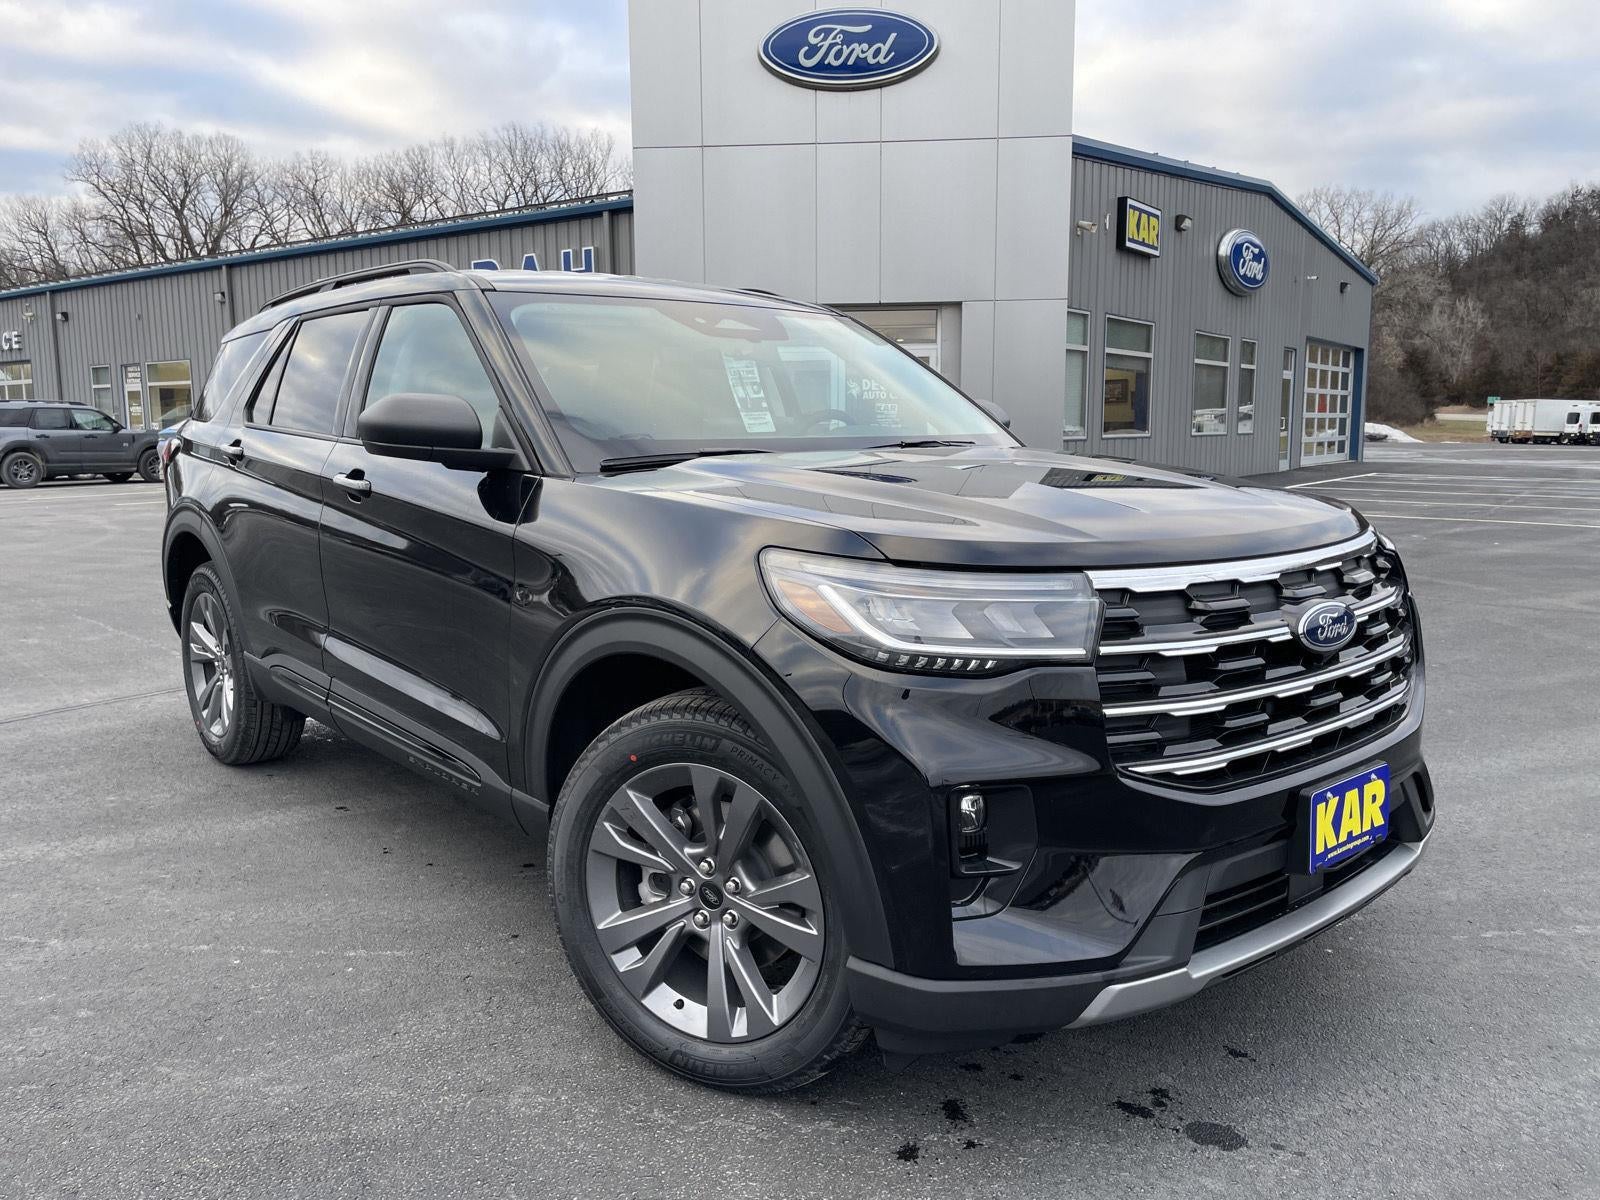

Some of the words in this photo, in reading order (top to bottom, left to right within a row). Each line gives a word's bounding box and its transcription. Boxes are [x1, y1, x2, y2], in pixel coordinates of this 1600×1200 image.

[798, 24, 898, 68] Ford
[1128, 208, 1159, 246] KAR
[1239, 242, 1264, 281] Ford
[862, 391, 887, 400] AUTO
[1317, 612, 1349, 641] Ford
[730, 745, 780, 782] PRIMACY
[1316, 779, 1385, 855] KAR
